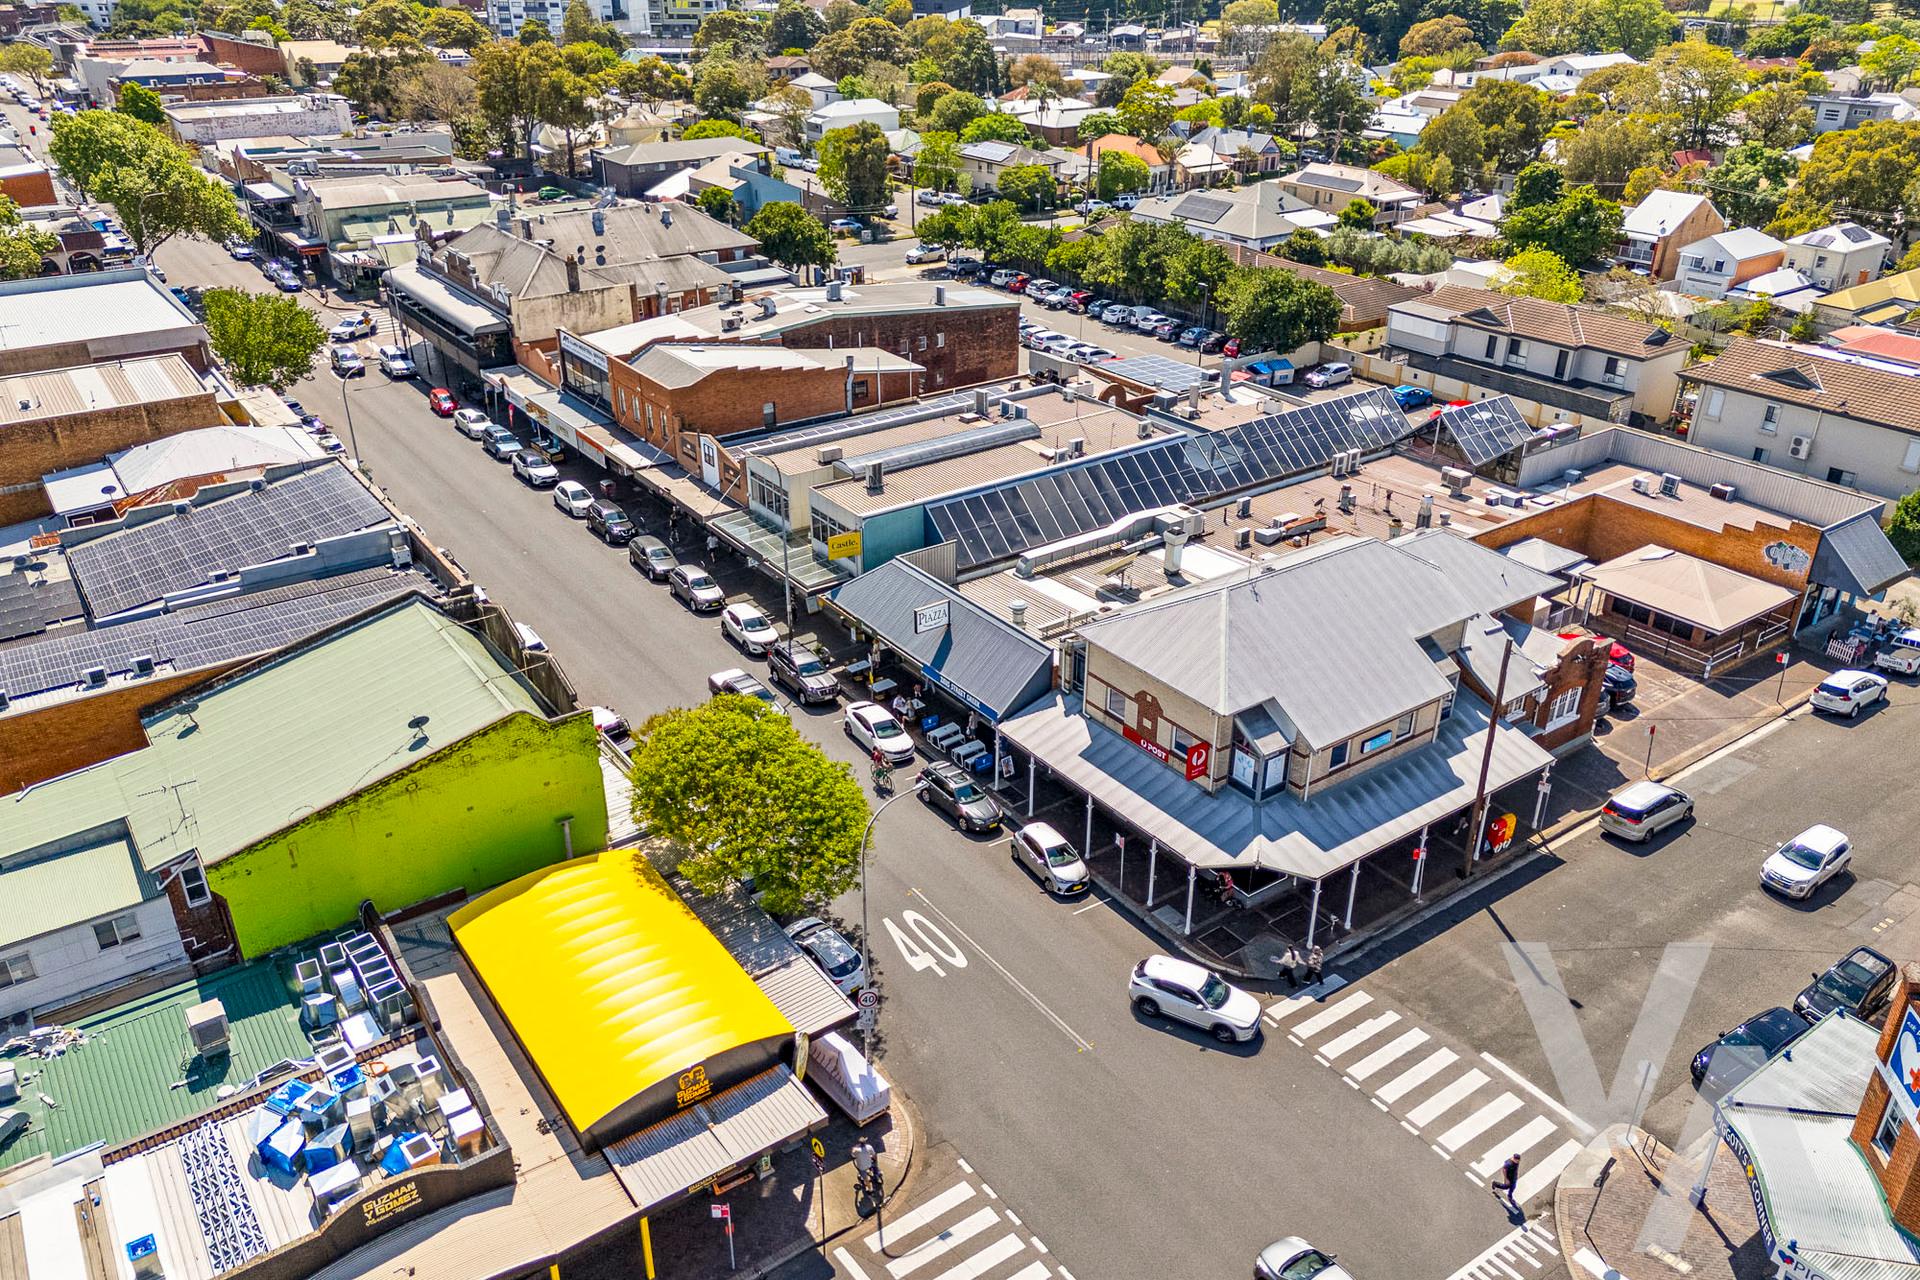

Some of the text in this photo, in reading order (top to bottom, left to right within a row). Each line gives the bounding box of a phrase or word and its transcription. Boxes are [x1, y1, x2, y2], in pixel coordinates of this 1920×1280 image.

[918, 608, 947, 626] PIAZZA
[1881, 657, 1903, 667] TOYOTA
[951, 683, 966, 698] STREET
[1147, 744, 1167, 760] POST
[882, 909, 968, 977] 40
[862, 995, 875, 1004] 40
[1715, 1113, 1773, 1246] PIGGOTT'S CORNER
[362, 1181, 416, 1213] GUZMAN
[364, 1189, 419, 1220] Y GOMEZ
